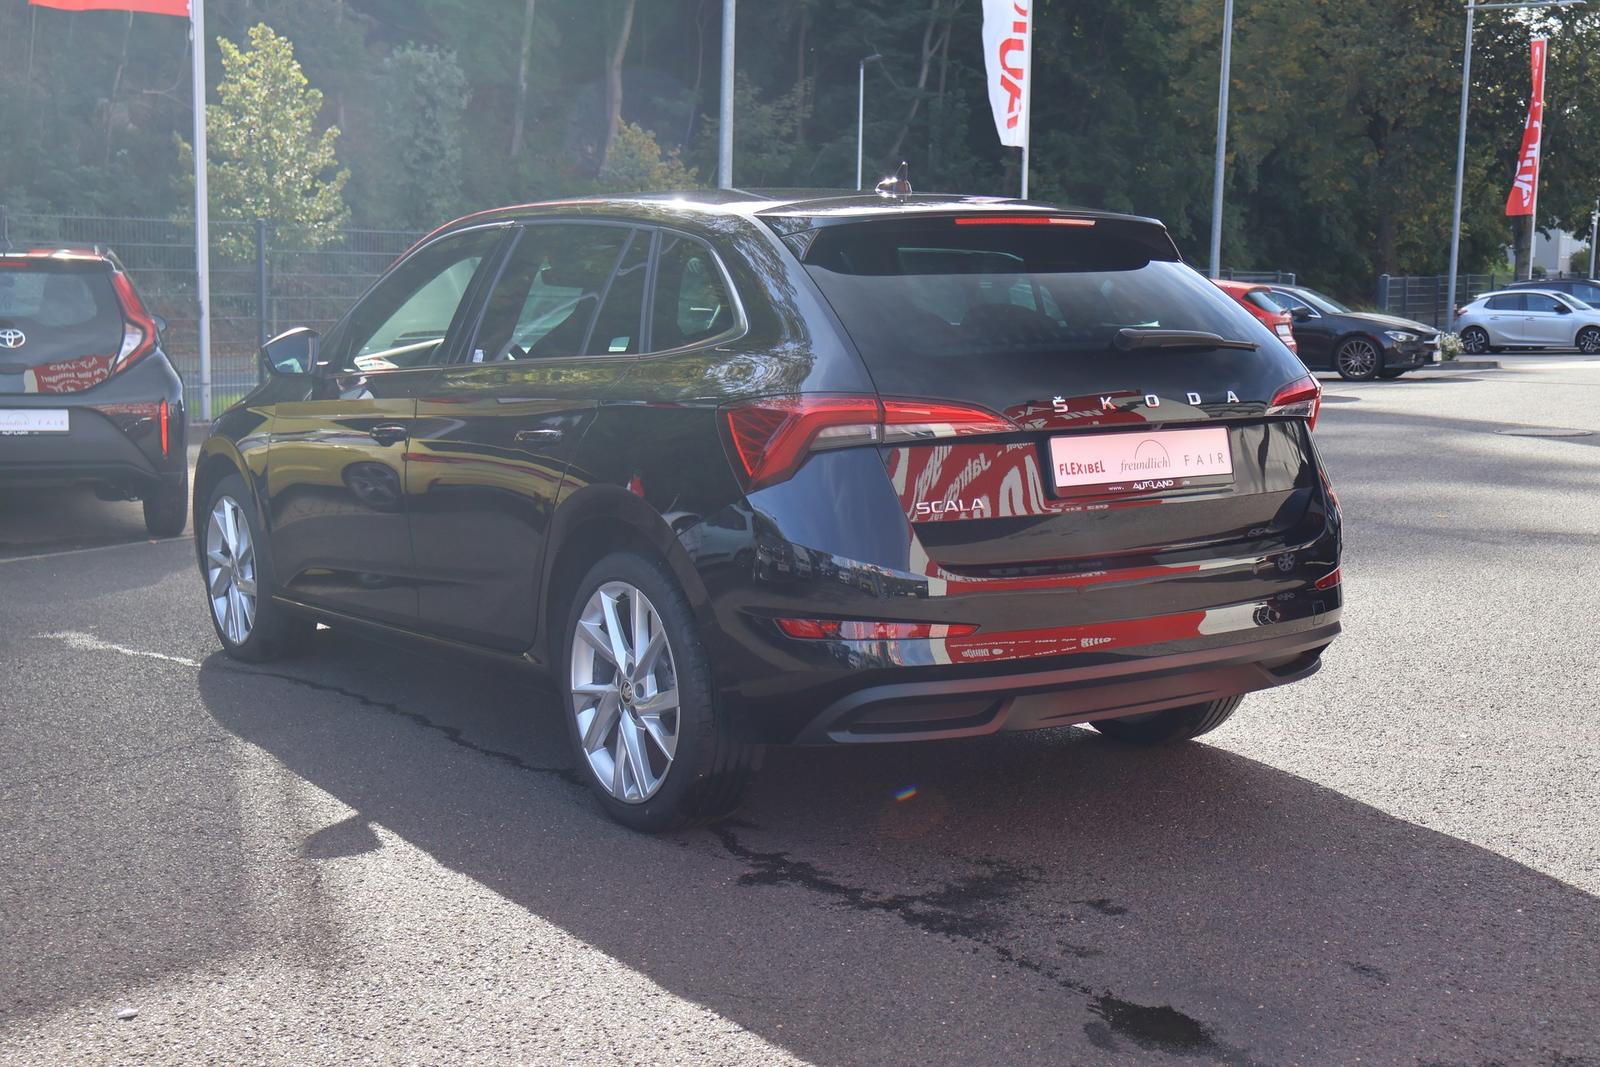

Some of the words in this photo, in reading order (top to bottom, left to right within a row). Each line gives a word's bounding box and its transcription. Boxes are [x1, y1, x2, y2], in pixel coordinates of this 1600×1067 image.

[1052, 391, 1240, 413] ŠKODA
[1059, 460, 1105, 476] FLEXIBEL
[1120, 457, 1169, 475] freundlich
[1184, 452, 1224, 466] FAIR
[1132, 480, 1174, 490] AUTOLAND
[915, 498, 985, 515] SCALA
